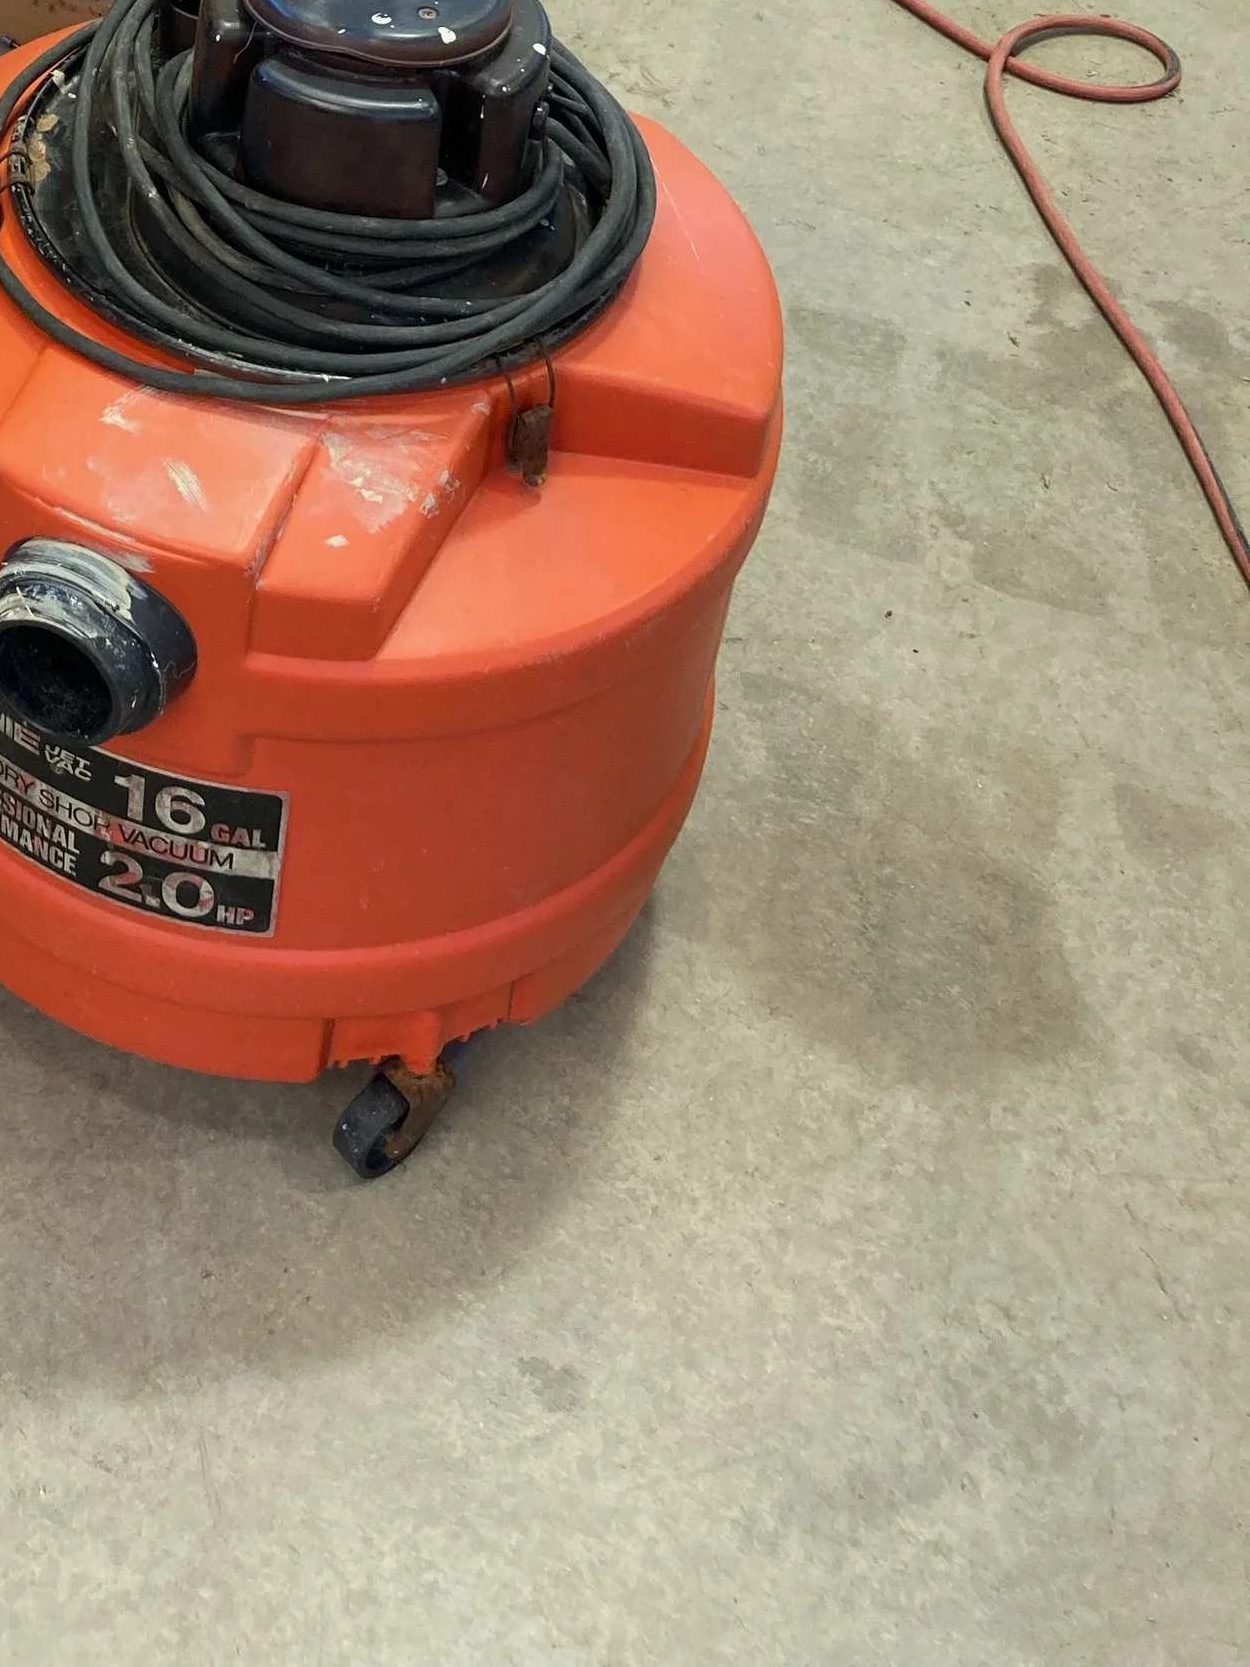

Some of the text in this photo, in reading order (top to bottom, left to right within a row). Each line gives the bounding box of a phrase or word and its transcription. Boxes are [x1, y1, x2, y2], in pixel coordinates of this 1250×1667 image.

[45, 744, 91, 769] JET
[45, 750, 92, 781] VAC
[39, 789, 111, 831] SHOP
[118, 823, 234, 871] VACUUM
[114, 774, 267, 849] 16 GAL
[98, 850, 255, 926] 2.0 HP
